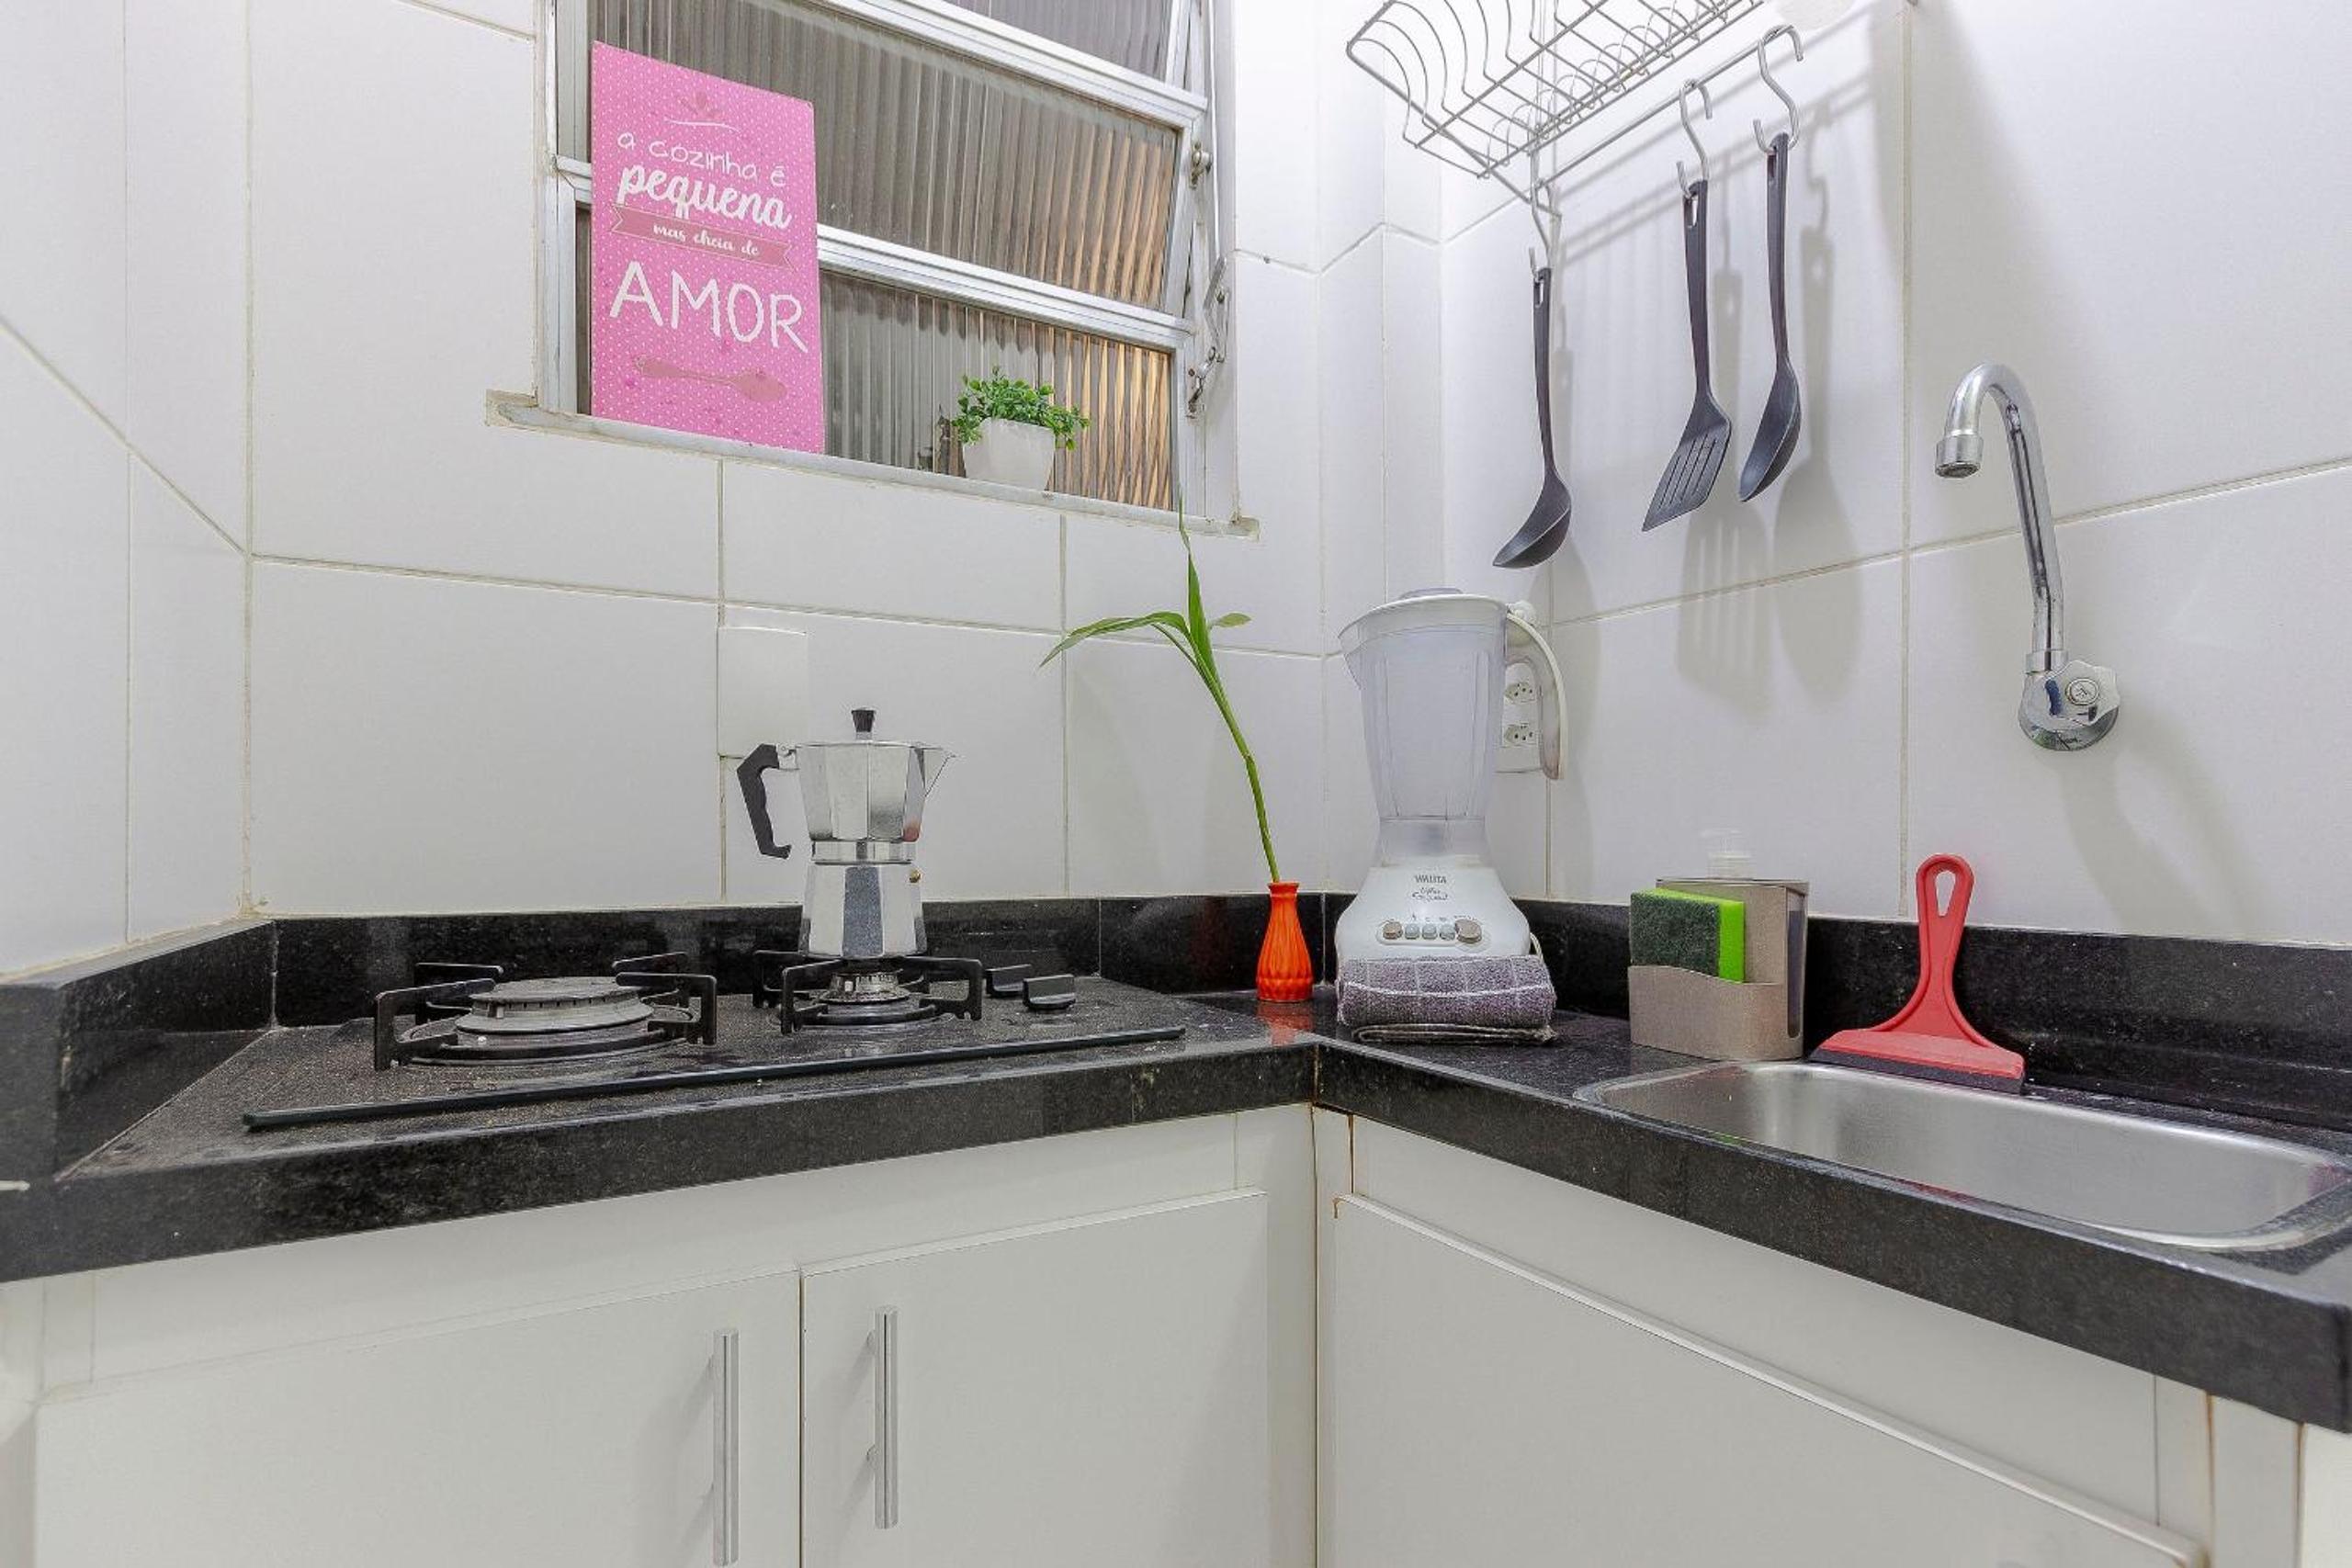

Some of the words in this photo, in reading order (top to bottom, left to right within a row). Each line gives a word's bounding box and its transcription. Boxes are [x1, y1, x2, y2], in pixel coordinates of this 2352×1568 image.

[616, 131, 636, 150] a
[648, 141, 758, 181] cozinha
[770, 165, 786, 187] é
[616, 164, 792, 230] pequena
[653, 223, 688, 243] mas
[693, 229, 736, 253] cheia
[741, 240, 760, 257] de
[609, 260, 808, 353] AMOR
[1414, 874, 1448, 885] WALITA
